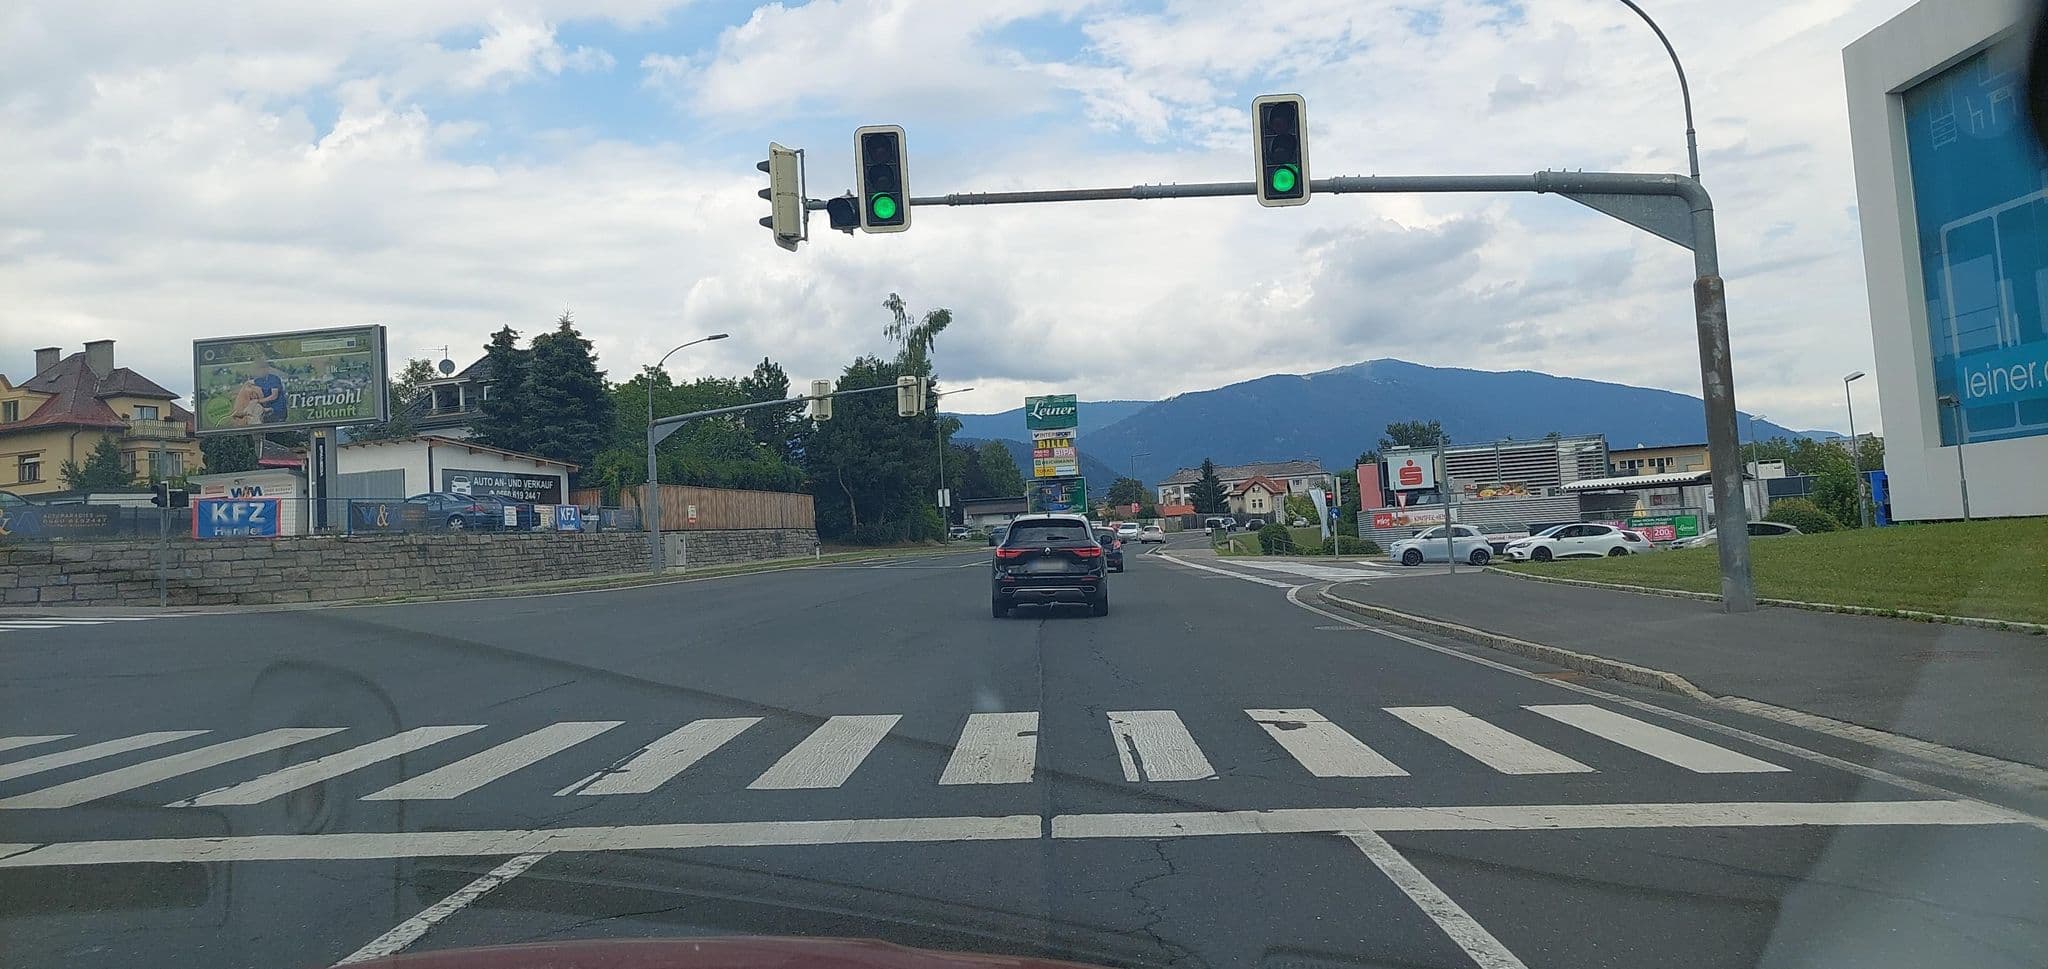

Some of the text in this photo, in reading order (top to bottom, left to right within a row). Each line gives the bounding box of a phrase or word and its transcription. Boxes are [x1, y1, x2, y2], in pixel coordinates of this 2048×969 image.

[1964, 360, 2048, 399] leiner.
[289, 389, 361, 408] Tierwohl
[307, 405, 356, 419] Zukunft
[1029, 400, 1074, 419] Leiner
[1038, 440, 1068, 448] BILLA
[1054, 448, 1075, 456] BIPA
[473, 476, 554, 489] AUTO AN- UND VERKAUF
[210, 502, 266, 522] KFZ
[560, 507, 576, 521] KFZ
